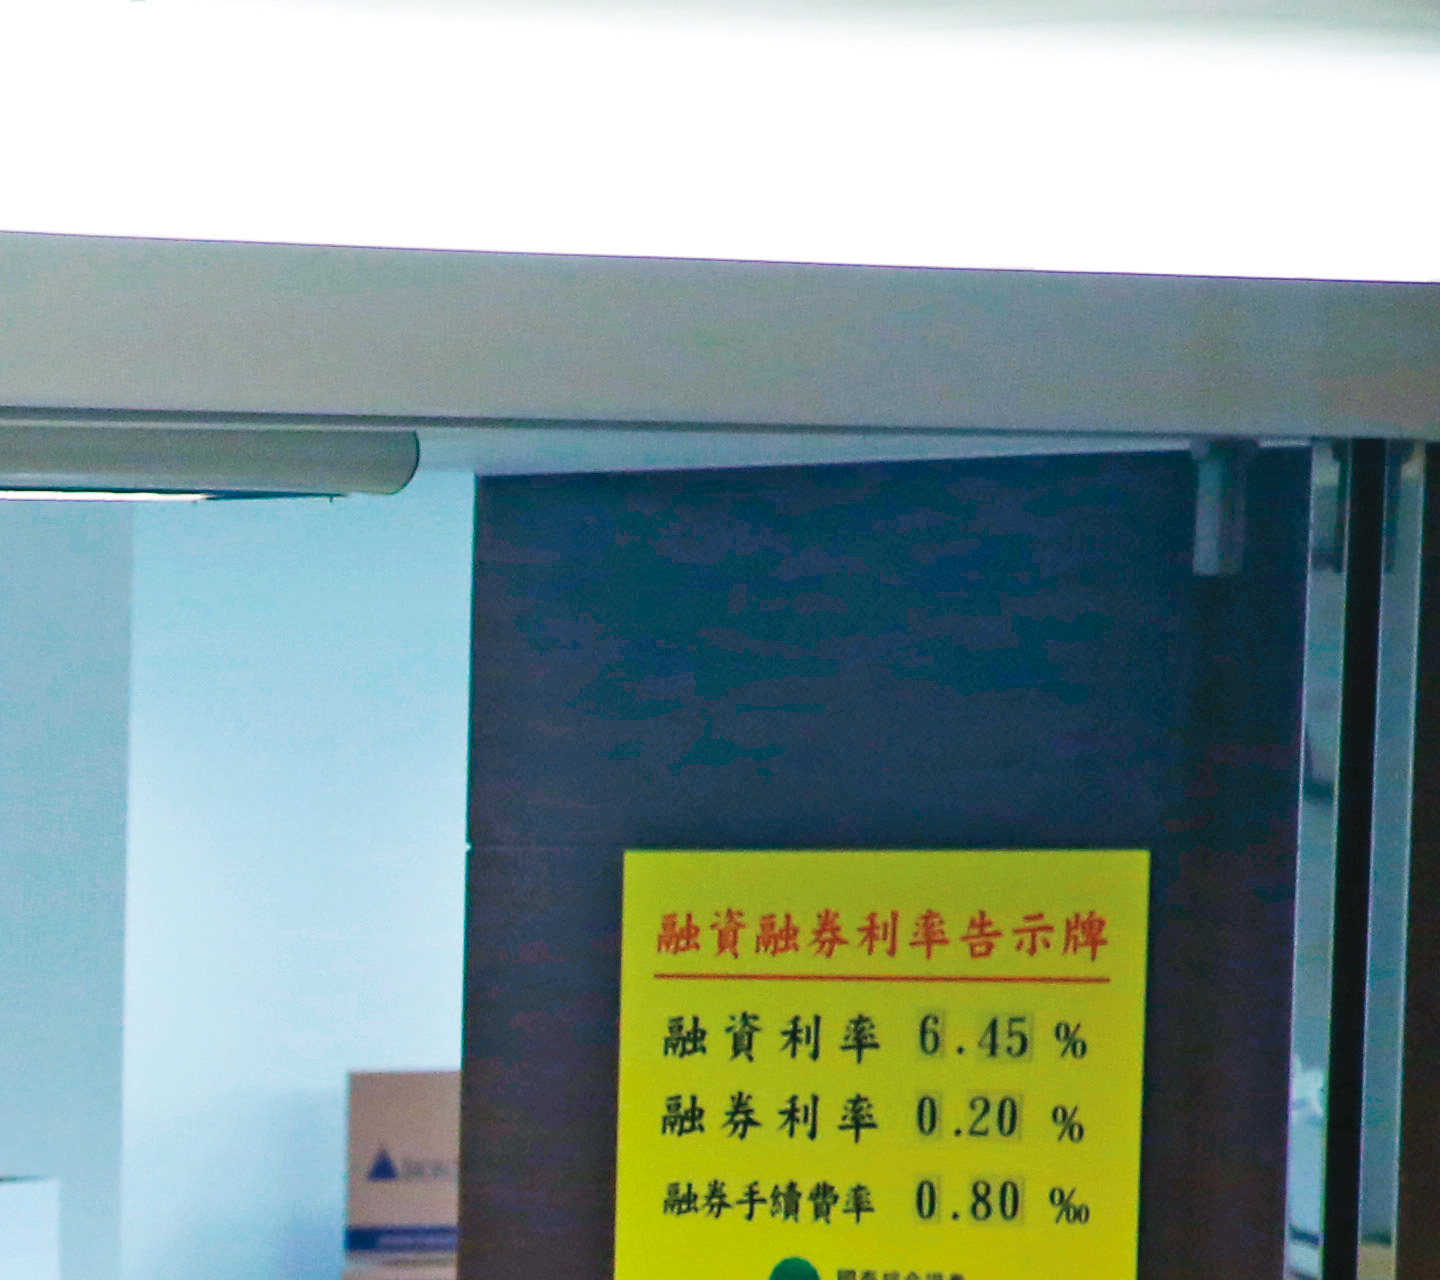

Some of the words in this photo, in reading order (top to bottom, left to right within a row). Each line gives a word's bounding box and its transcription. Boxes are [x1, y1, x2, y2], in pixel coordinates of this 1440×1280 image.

[656, 906, 1110, 962] 融資融券利率告示牌
[664, 1010, 880, 1064] 融資利率
[661, 1091, 879, 1143] 融券利率
[664, 1178, 876, 1225] 融券手續費率
